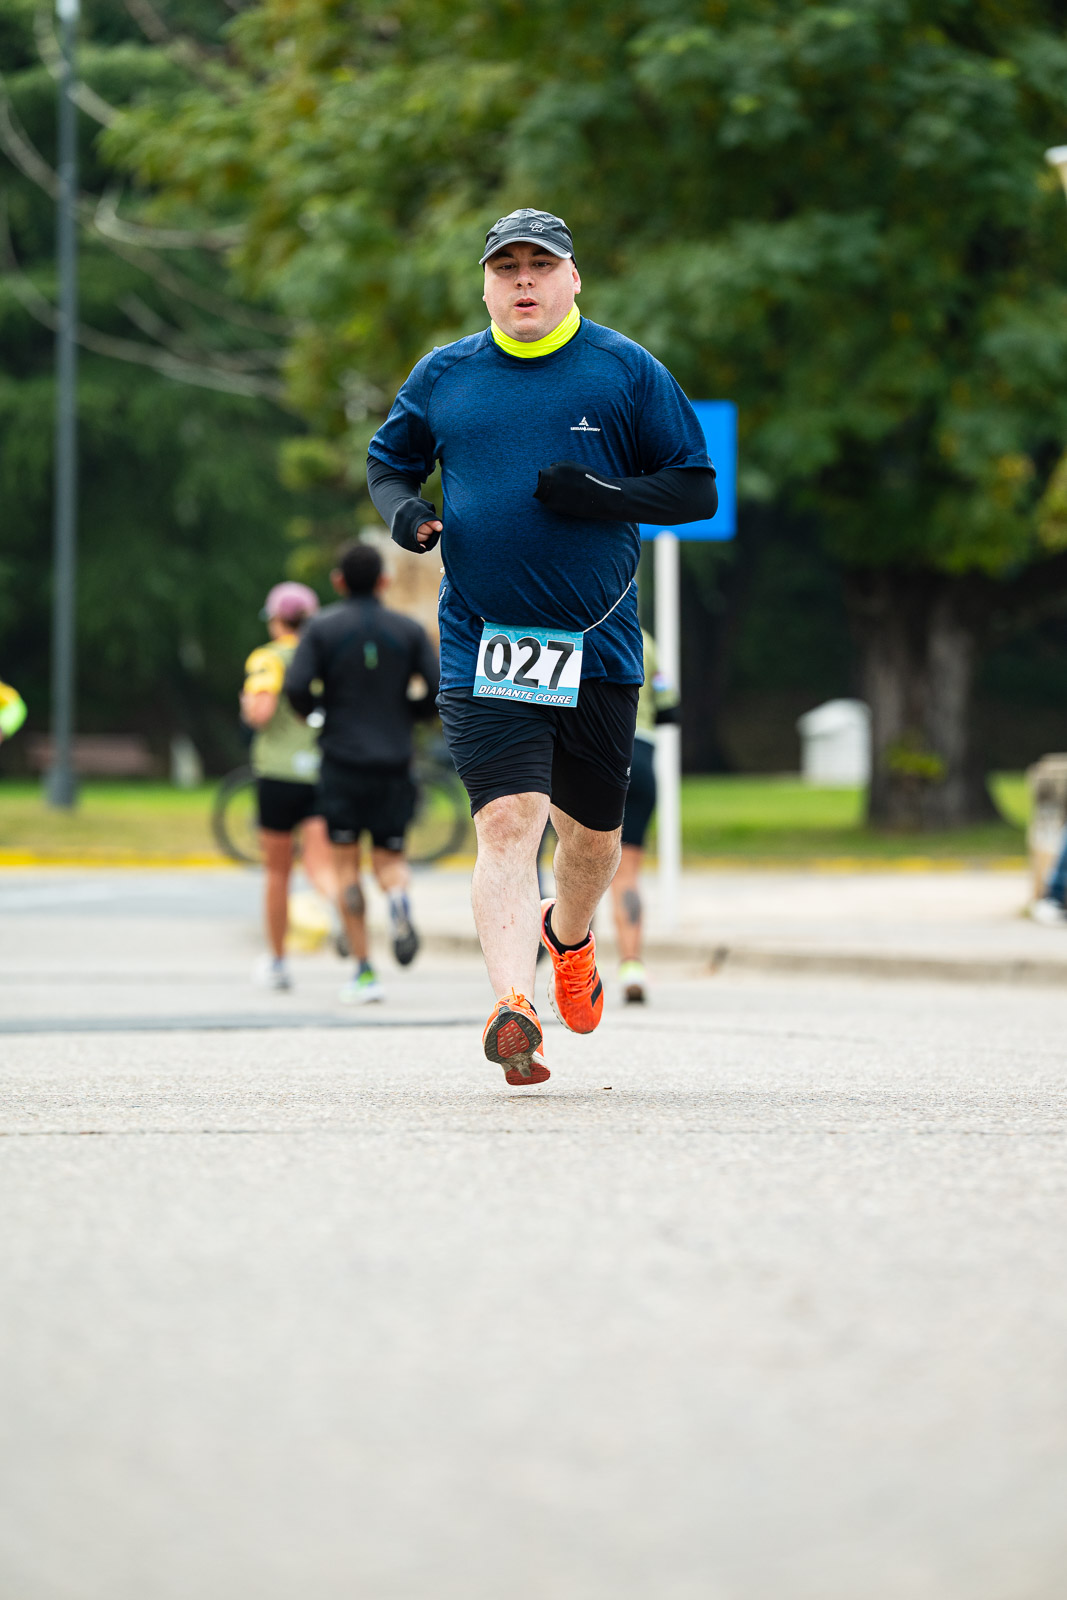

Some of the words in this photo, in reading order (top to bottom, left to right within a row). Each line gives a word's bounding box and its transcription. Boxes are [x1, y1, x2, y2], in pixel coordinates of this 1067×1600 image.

[484, 634, 575, 690] 027
[478, 685, 534, 700] DIAMANTE
[535, 694, 573, 704] CORRE
